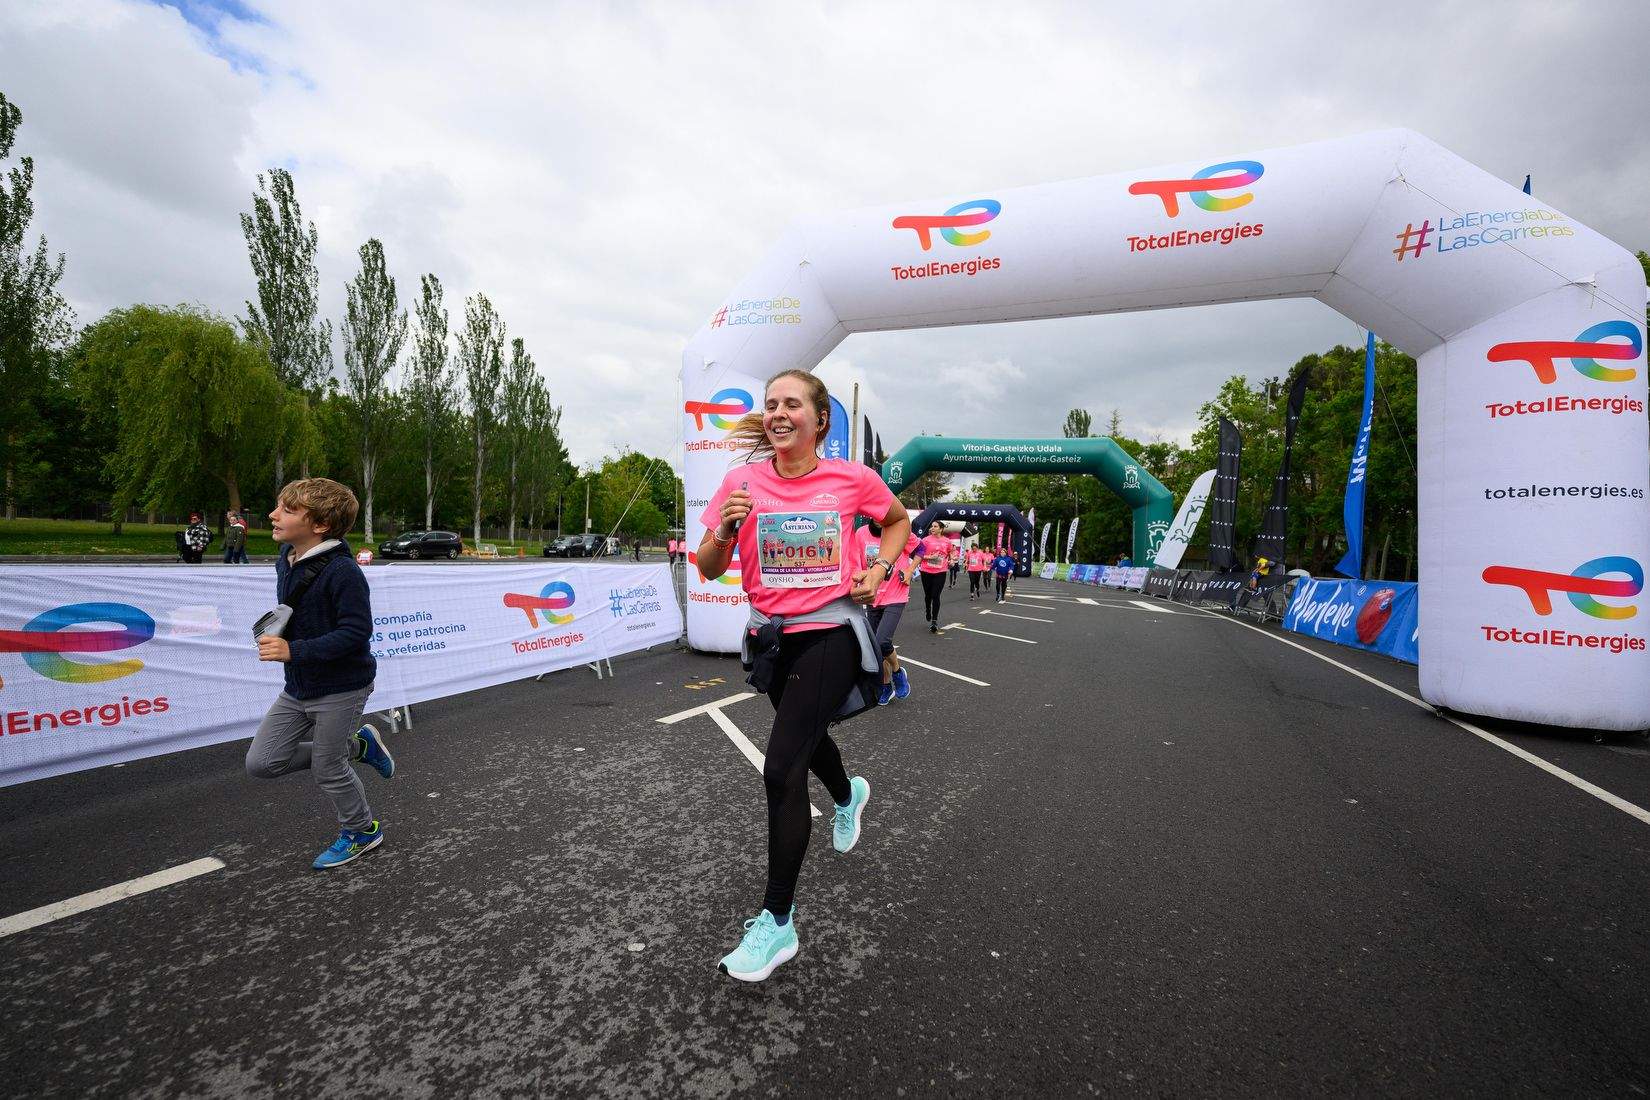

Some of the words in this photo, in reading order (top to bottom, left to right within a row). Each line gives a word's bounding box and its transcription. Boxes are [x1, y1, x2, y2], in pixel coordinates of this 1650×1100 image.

[1127, 222, 1263, 253] TotalEnergies
[1438, 225, 1575, 253] LasCarreras
[891, 256, 1001, 281] TotalEnergies
[727, 312, 802, 326] LasCarreras
[1485, 394, 1644, 419] TotalEnergies
[962, 443, 1034, 452] Vitoria-Gasteizko
[1037, 444, 1063, 453] Udala
[943, 453, 1002, 463] Ayuntamiento
[1005, 454, 1016, 463] de
[1018, 454, 1082, 463] Vitoria-Gasteiz
[1484, 483, 1644, 500] totalenergies.es
[946, 509, 1003, 517] VOLVO
[1021, 531, 1029, 572] VOLVO
[1177, 581, 1208, 592] VOLVO
[1208, 580, 1241, 590] VOLVO
[1288, 580, 1355, 636] Marlene
[388, 630, 411, 642] que
[414, 623, 466, 639] patrocina
[1480, 626, 1646, 654] TotalEnergies
[386, 641, 446, 658] preferidas
[511, 632, 585, 655] TotalEnergies
